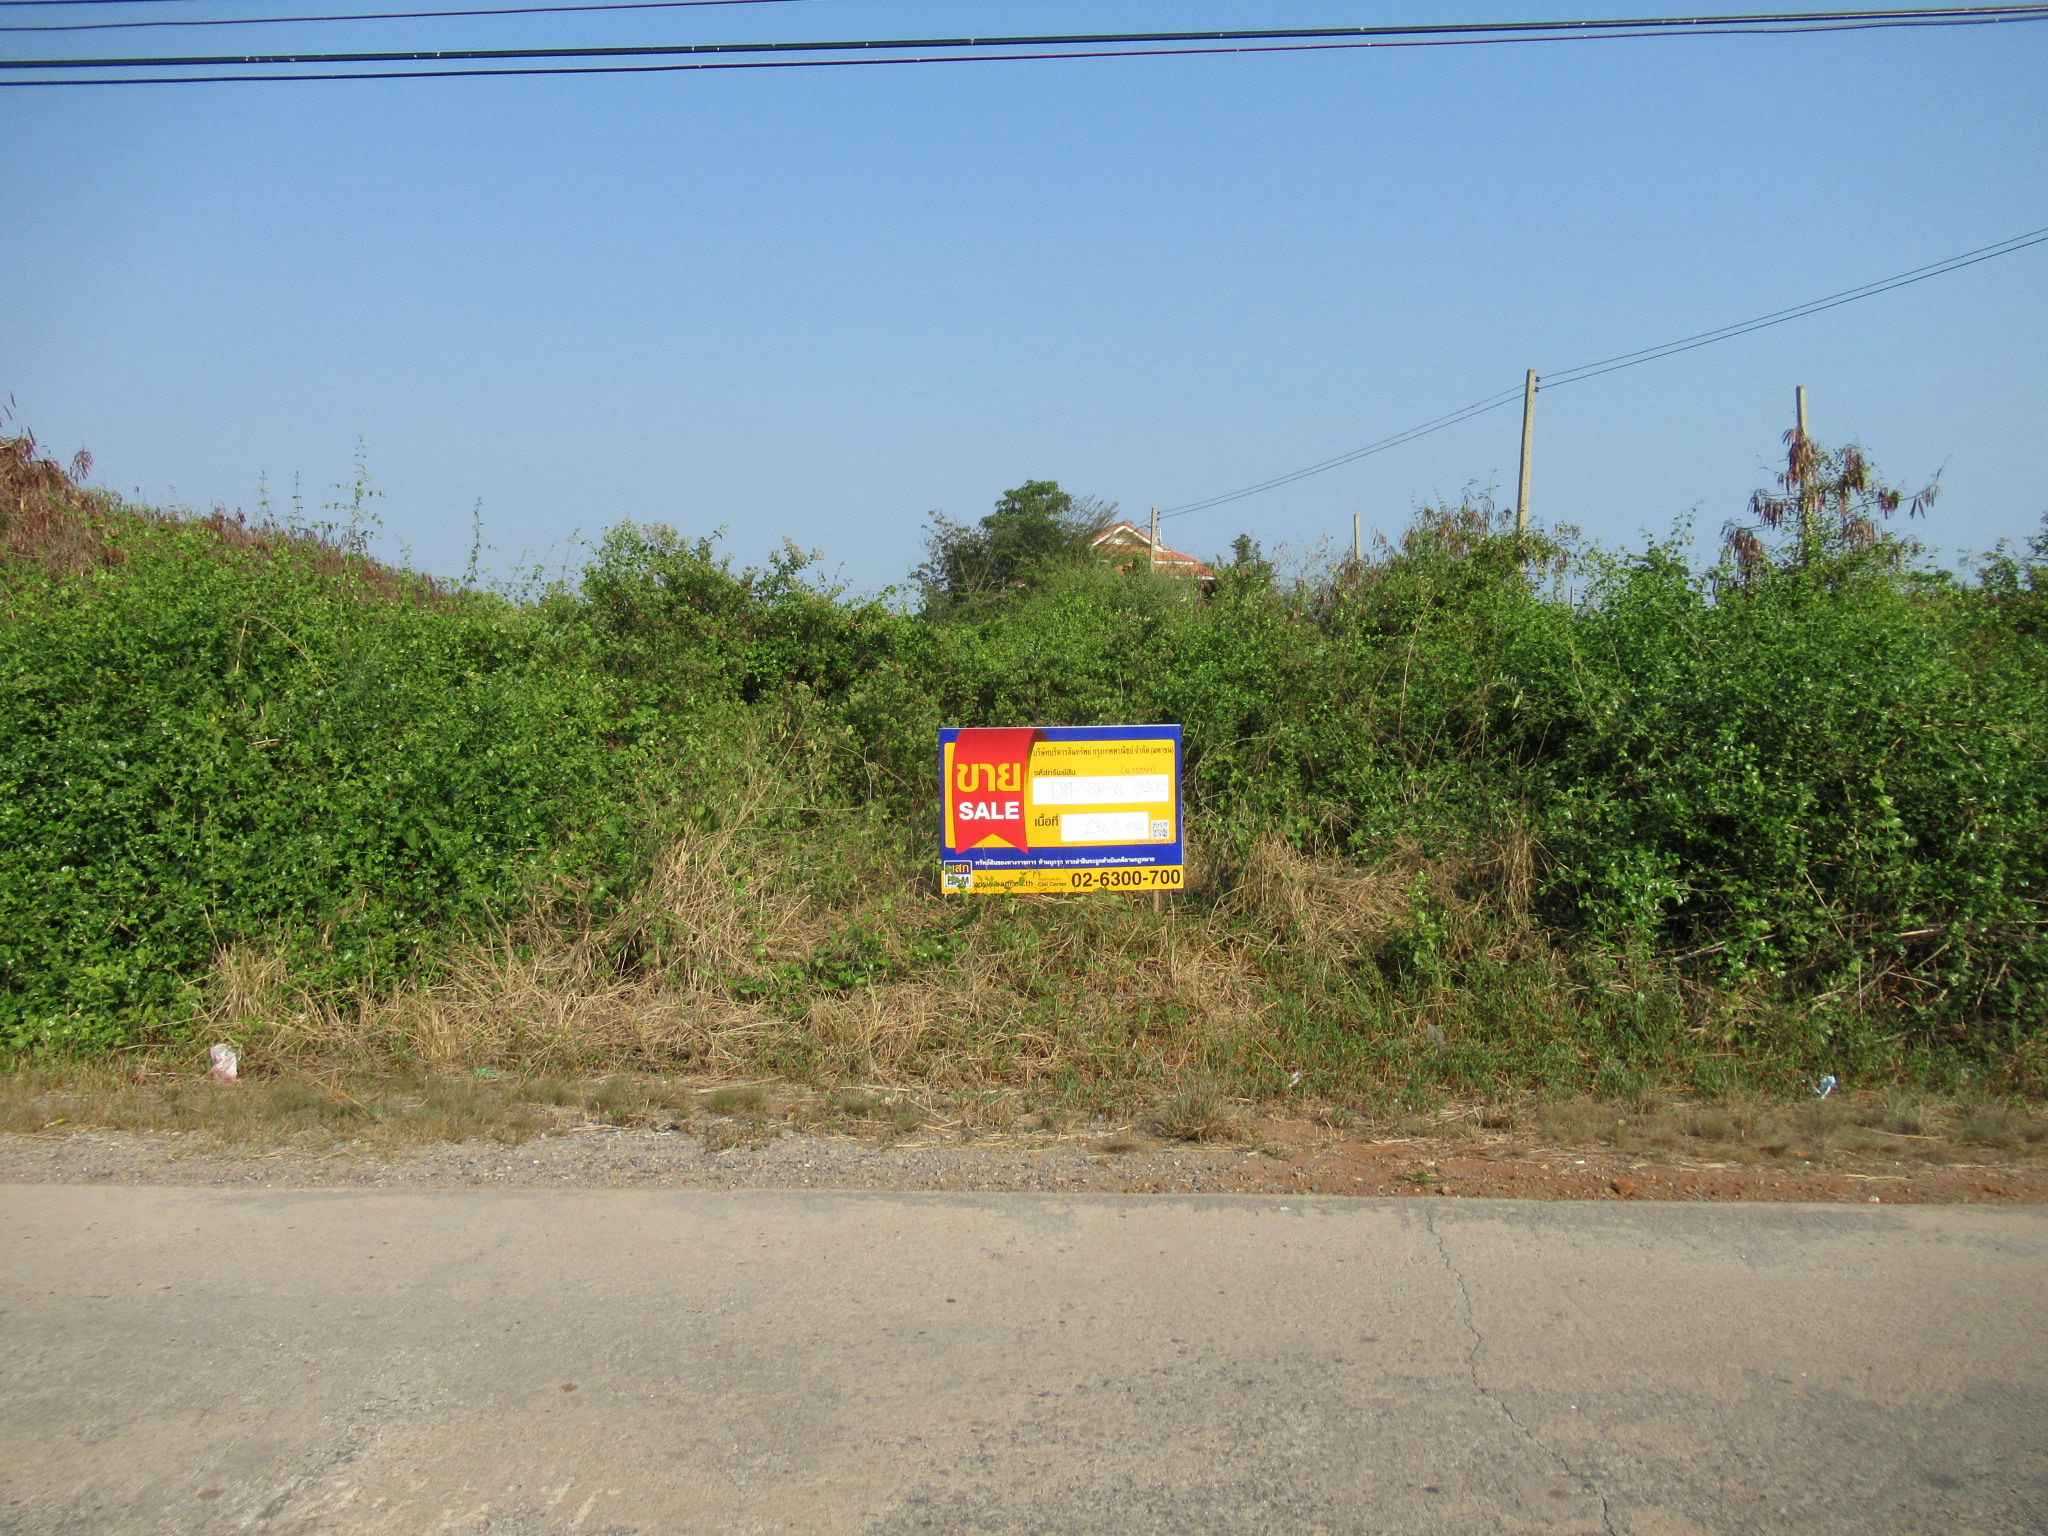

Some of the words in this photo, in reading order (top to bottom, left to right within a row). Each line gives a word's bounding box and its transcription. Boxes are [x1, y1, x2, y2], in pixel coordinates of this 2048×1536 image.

[956, 763, 1021, 792] ขาย
[958, 801, 1020, 821] SALE
[1034, 813, 1059, 828] เนื้อที่
[1071, 869, 1181, 888] 02-6300-700
